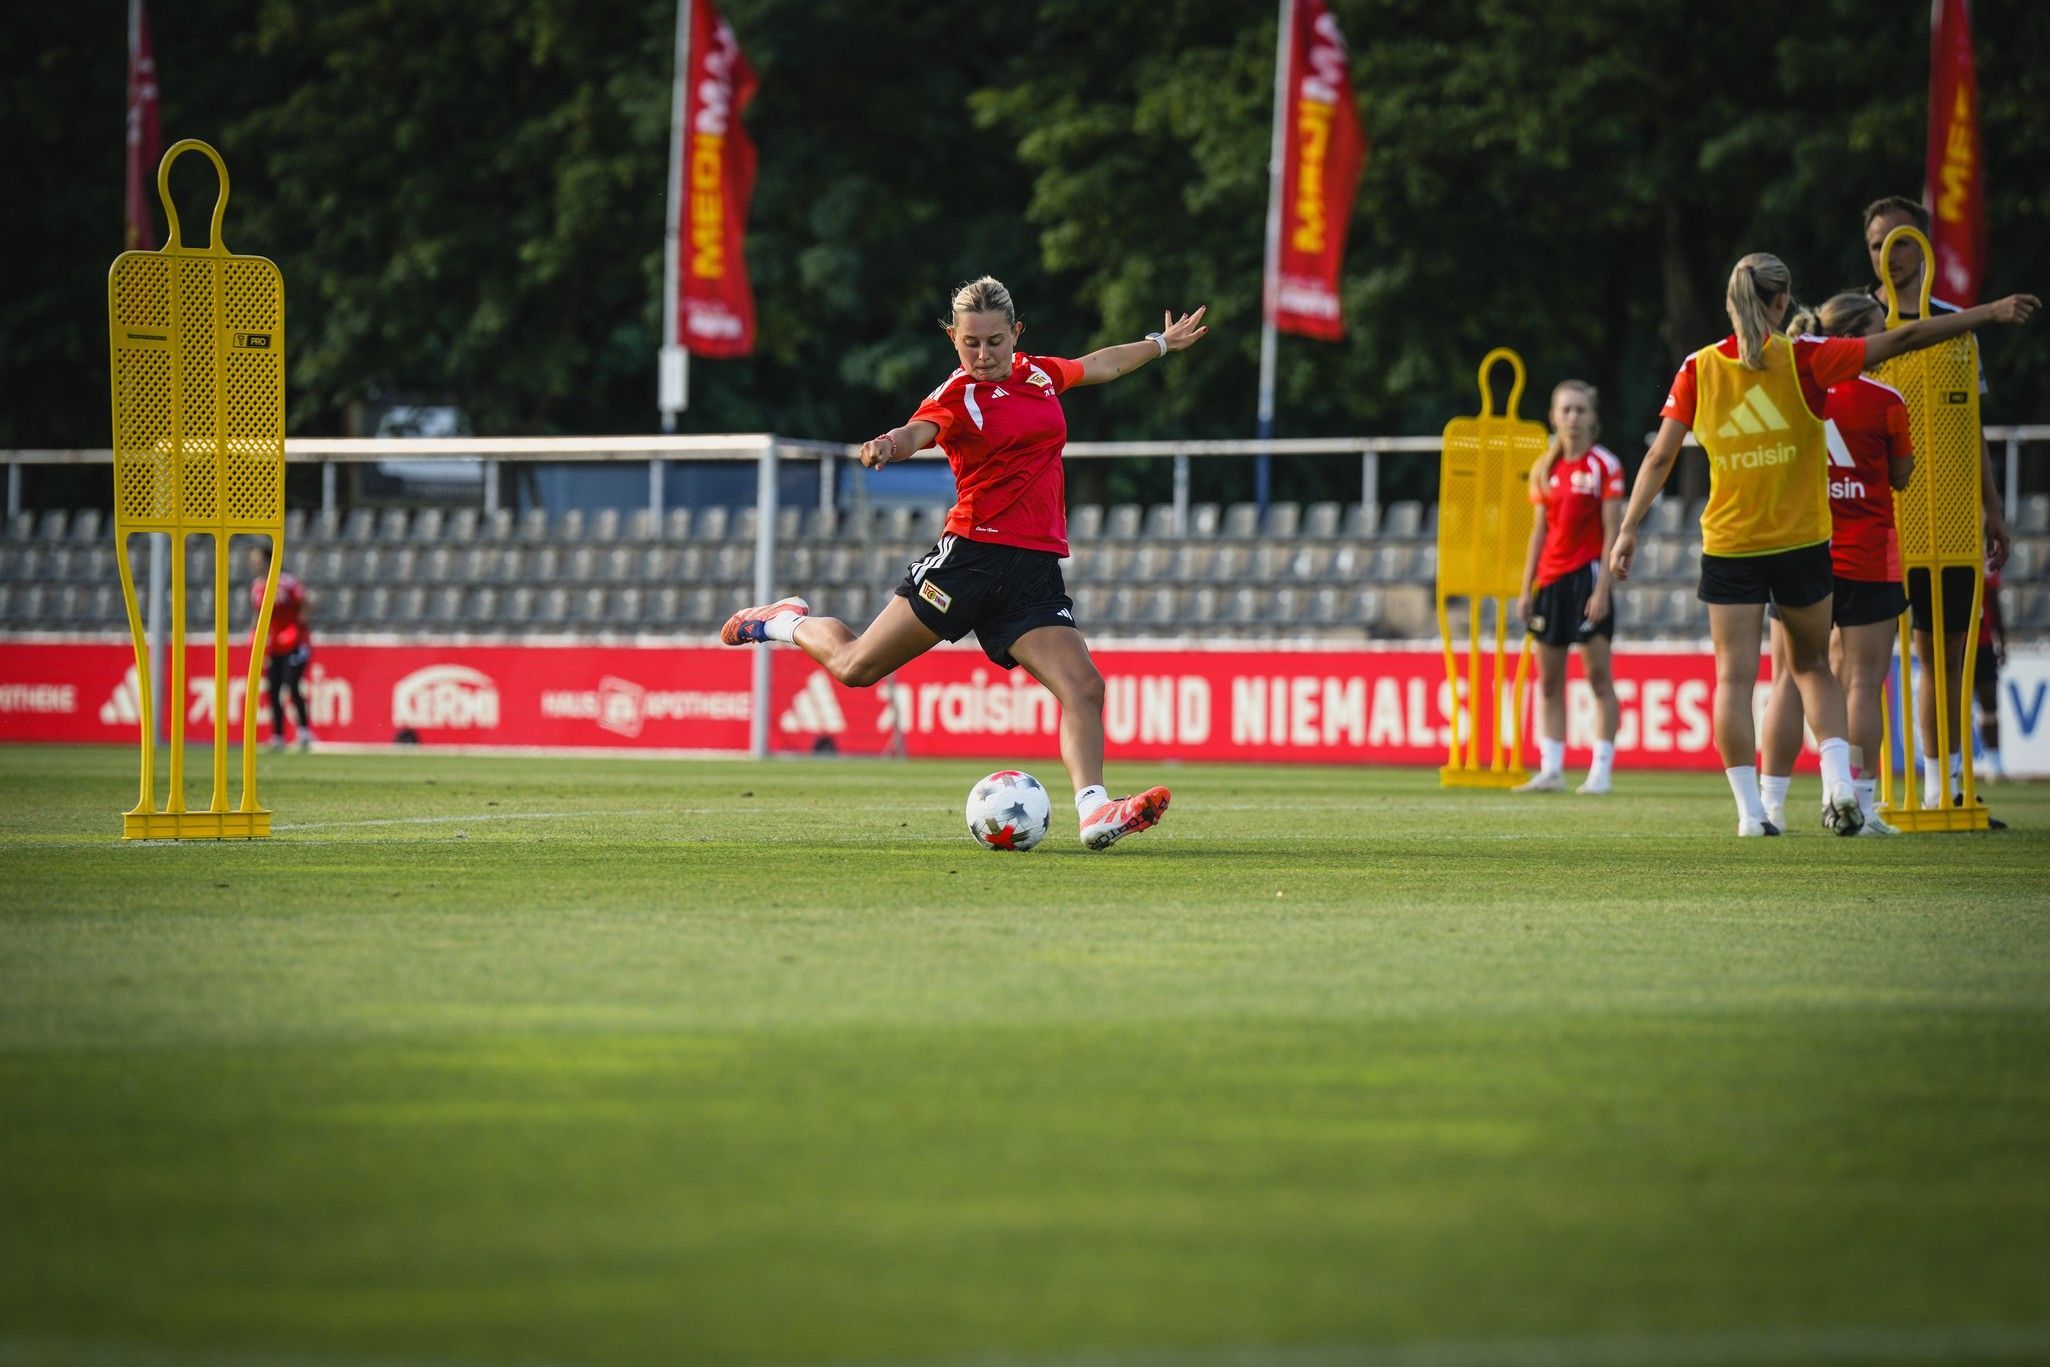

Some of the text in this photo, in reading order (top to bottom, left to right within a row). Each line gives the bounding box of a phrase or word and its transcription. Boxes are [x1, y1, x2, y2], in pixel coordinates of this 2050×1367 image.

[1731, 442, 1797, 470] raisin
[1828, 476, 1865, 499] isin
[918, 668, 1058, 734] raisin
[1106, 675, 1211, 744] UND
[1231, 676, 1470, 747] NIEMALS
[1089, 797, 1168, 850] PDATOR
